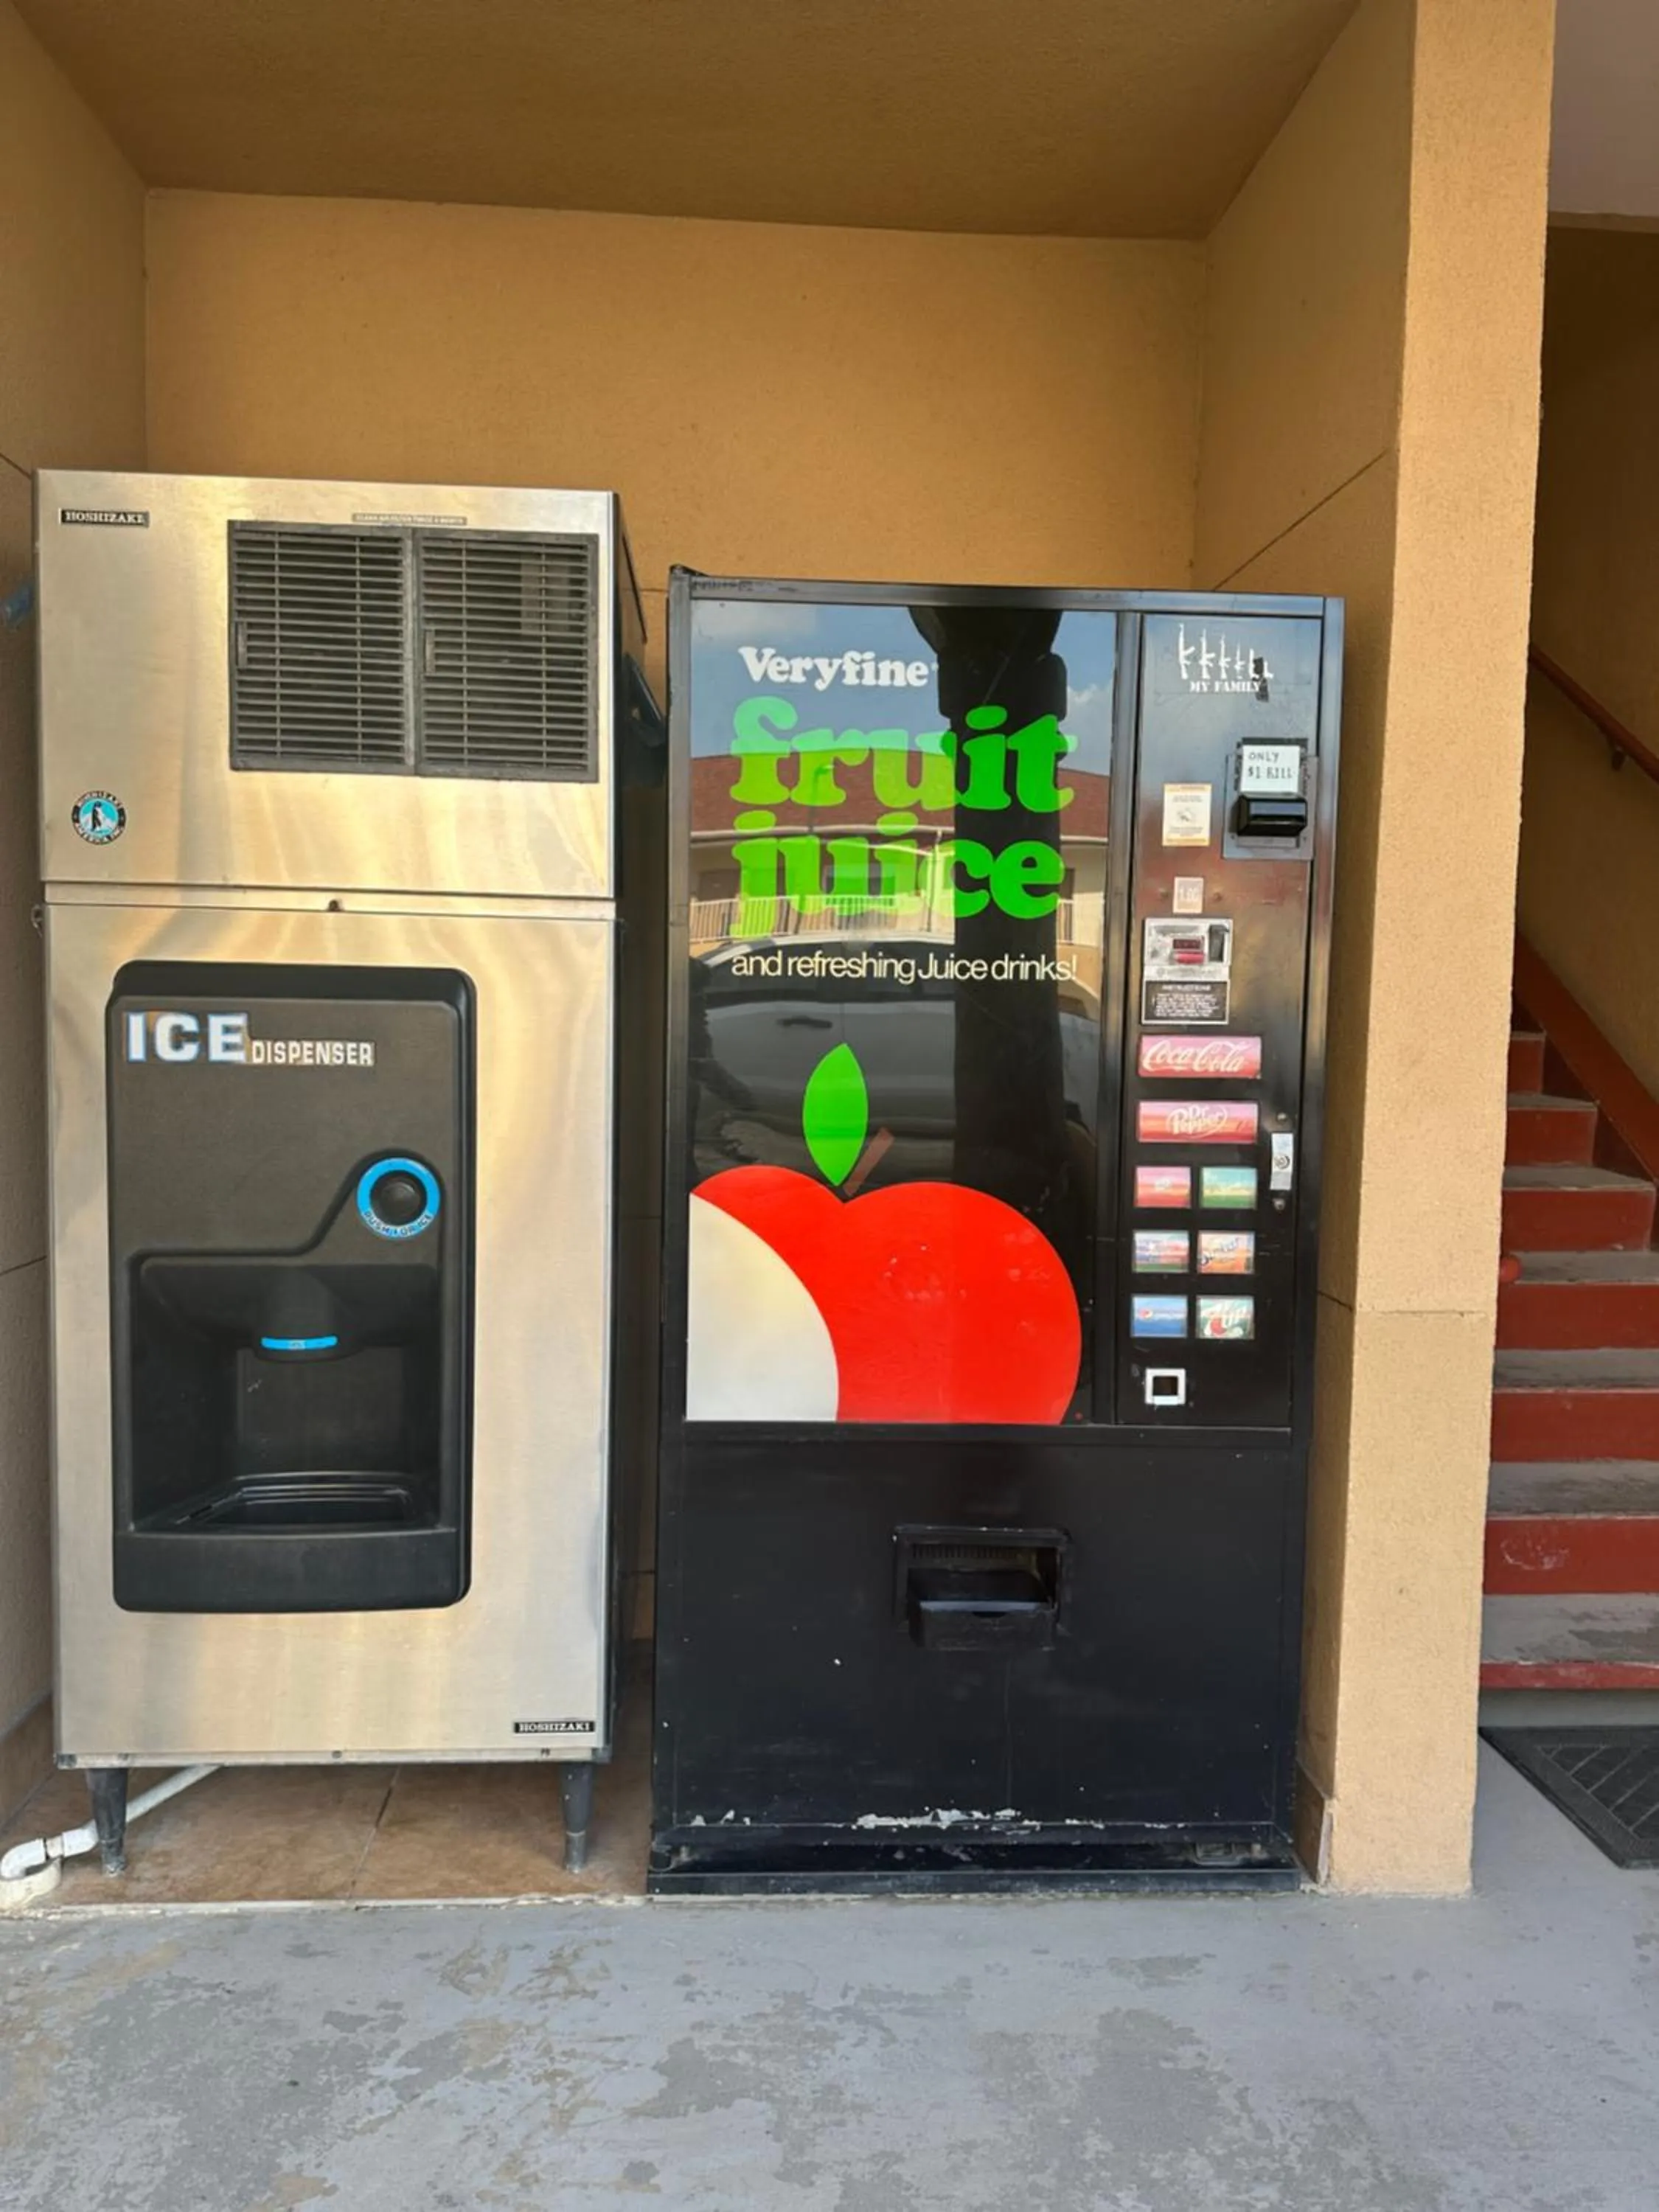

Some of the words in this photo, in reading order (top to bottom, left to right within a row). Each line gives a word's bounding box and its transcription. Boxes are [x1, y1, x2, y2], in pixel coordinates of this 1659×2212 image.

[738, 647, 929, 692] Veryfine
[1189, 681, 1211, 692] MY
[1214, 681, 1261, 692] FAMILY
[730, 696, 1079, 813] fruit
[1248, 751, 1279, 763] ONLY
[1248, 766, 1261, 779] $1
[1266, 767, 1294, 780] BILL
[730, 810, 1065, 939] juice
[732, 951, 782, 978] and
[787, 952, 916, 984] refreshing
[918, 955, 988, 981] Juice
[991, 955, 1077, 981] drinks!
[128, 1012, 248, 1062] ICE
[251, 1040, 374, 1067] DISPENSER
